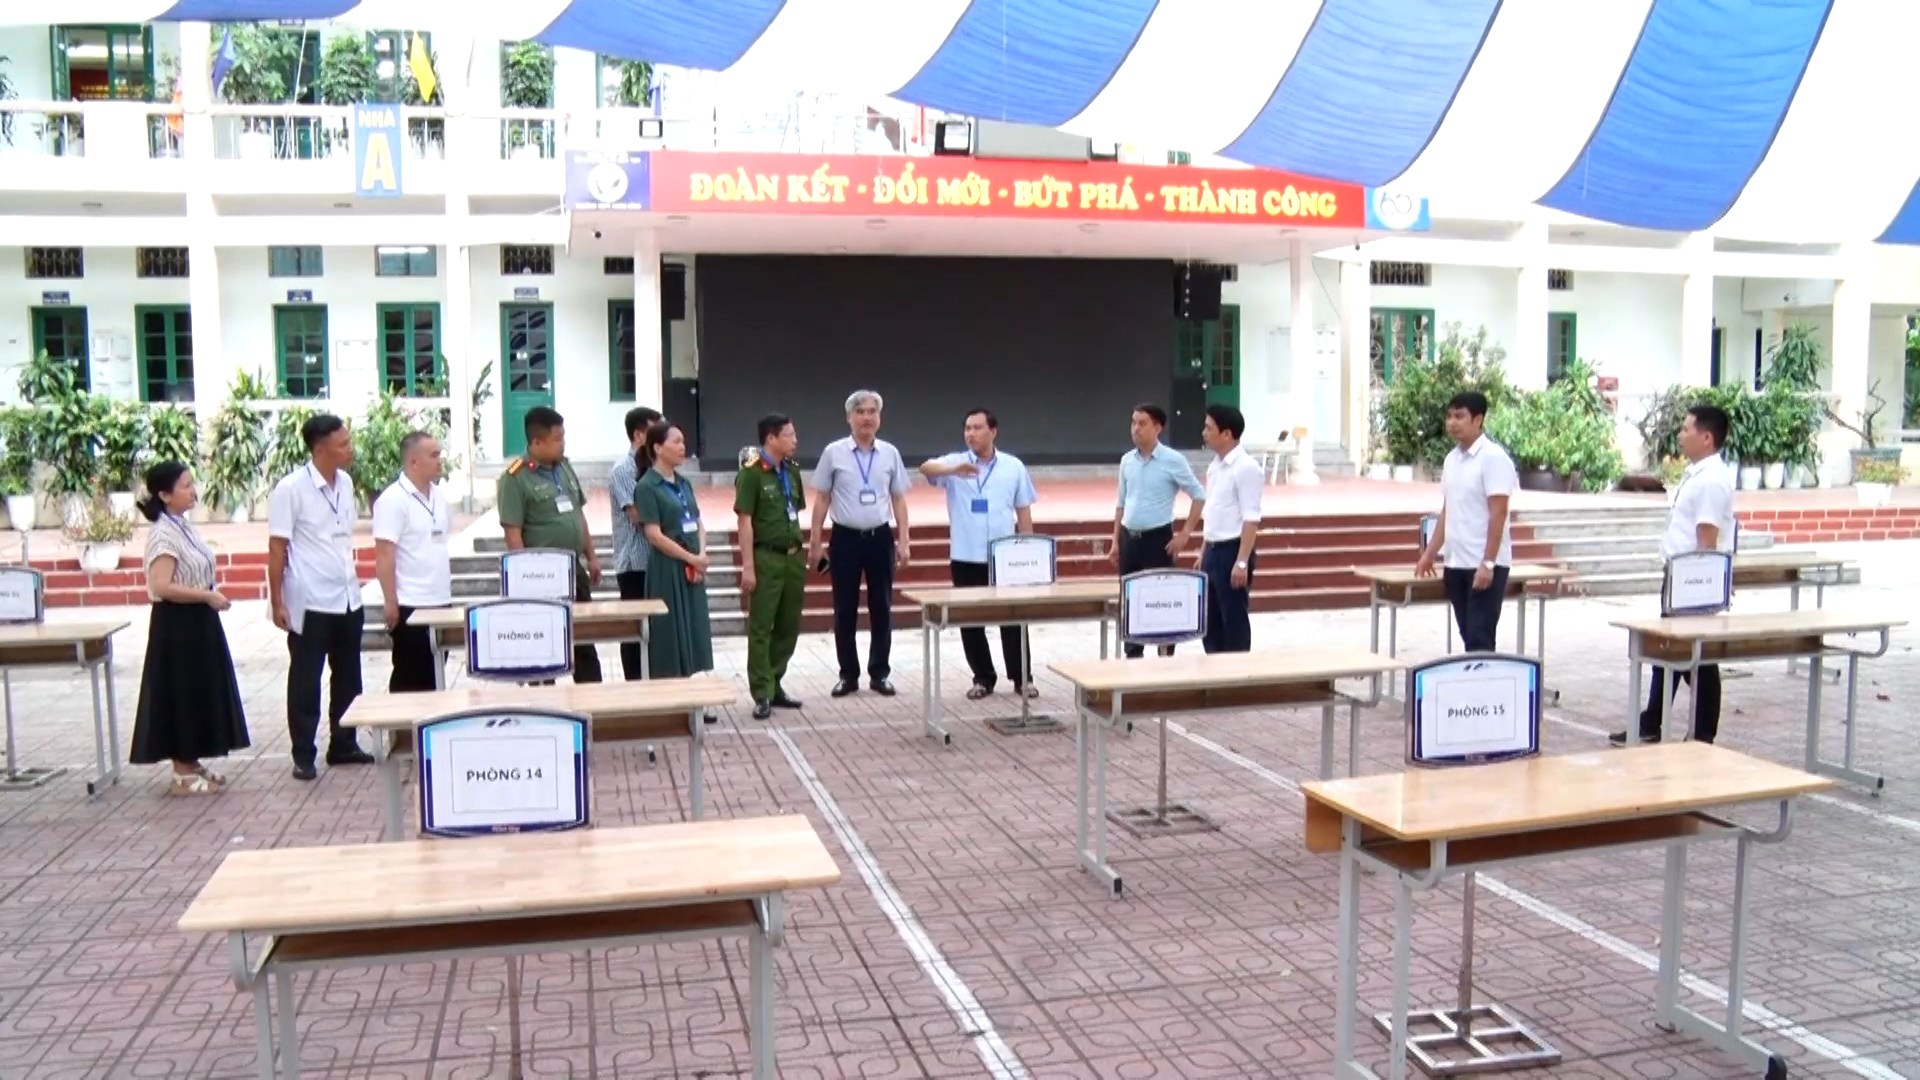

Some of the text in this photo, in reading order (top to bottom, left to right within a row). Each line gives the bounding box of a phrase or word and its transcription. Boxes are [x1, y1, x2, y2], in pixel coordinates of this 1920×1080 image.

[361, 132, 397, 190] A
[689, 166, 779, 201] ĐOÀN
[787, 162, 849, 203] KẾT
[873, 161, 928, 204] ĐỔI
[1014, 174, 1072, 208] BỨT
[1079, 176, 1139, 210] PHÁ
[1160, 179, 1257, 215] THÀNH
[1263, 185, 1337, 218] CÔNG
[1447, 703, 1505, 718] PHÒNG 15
[466, 767, 543, 782] PHÒNG 14
